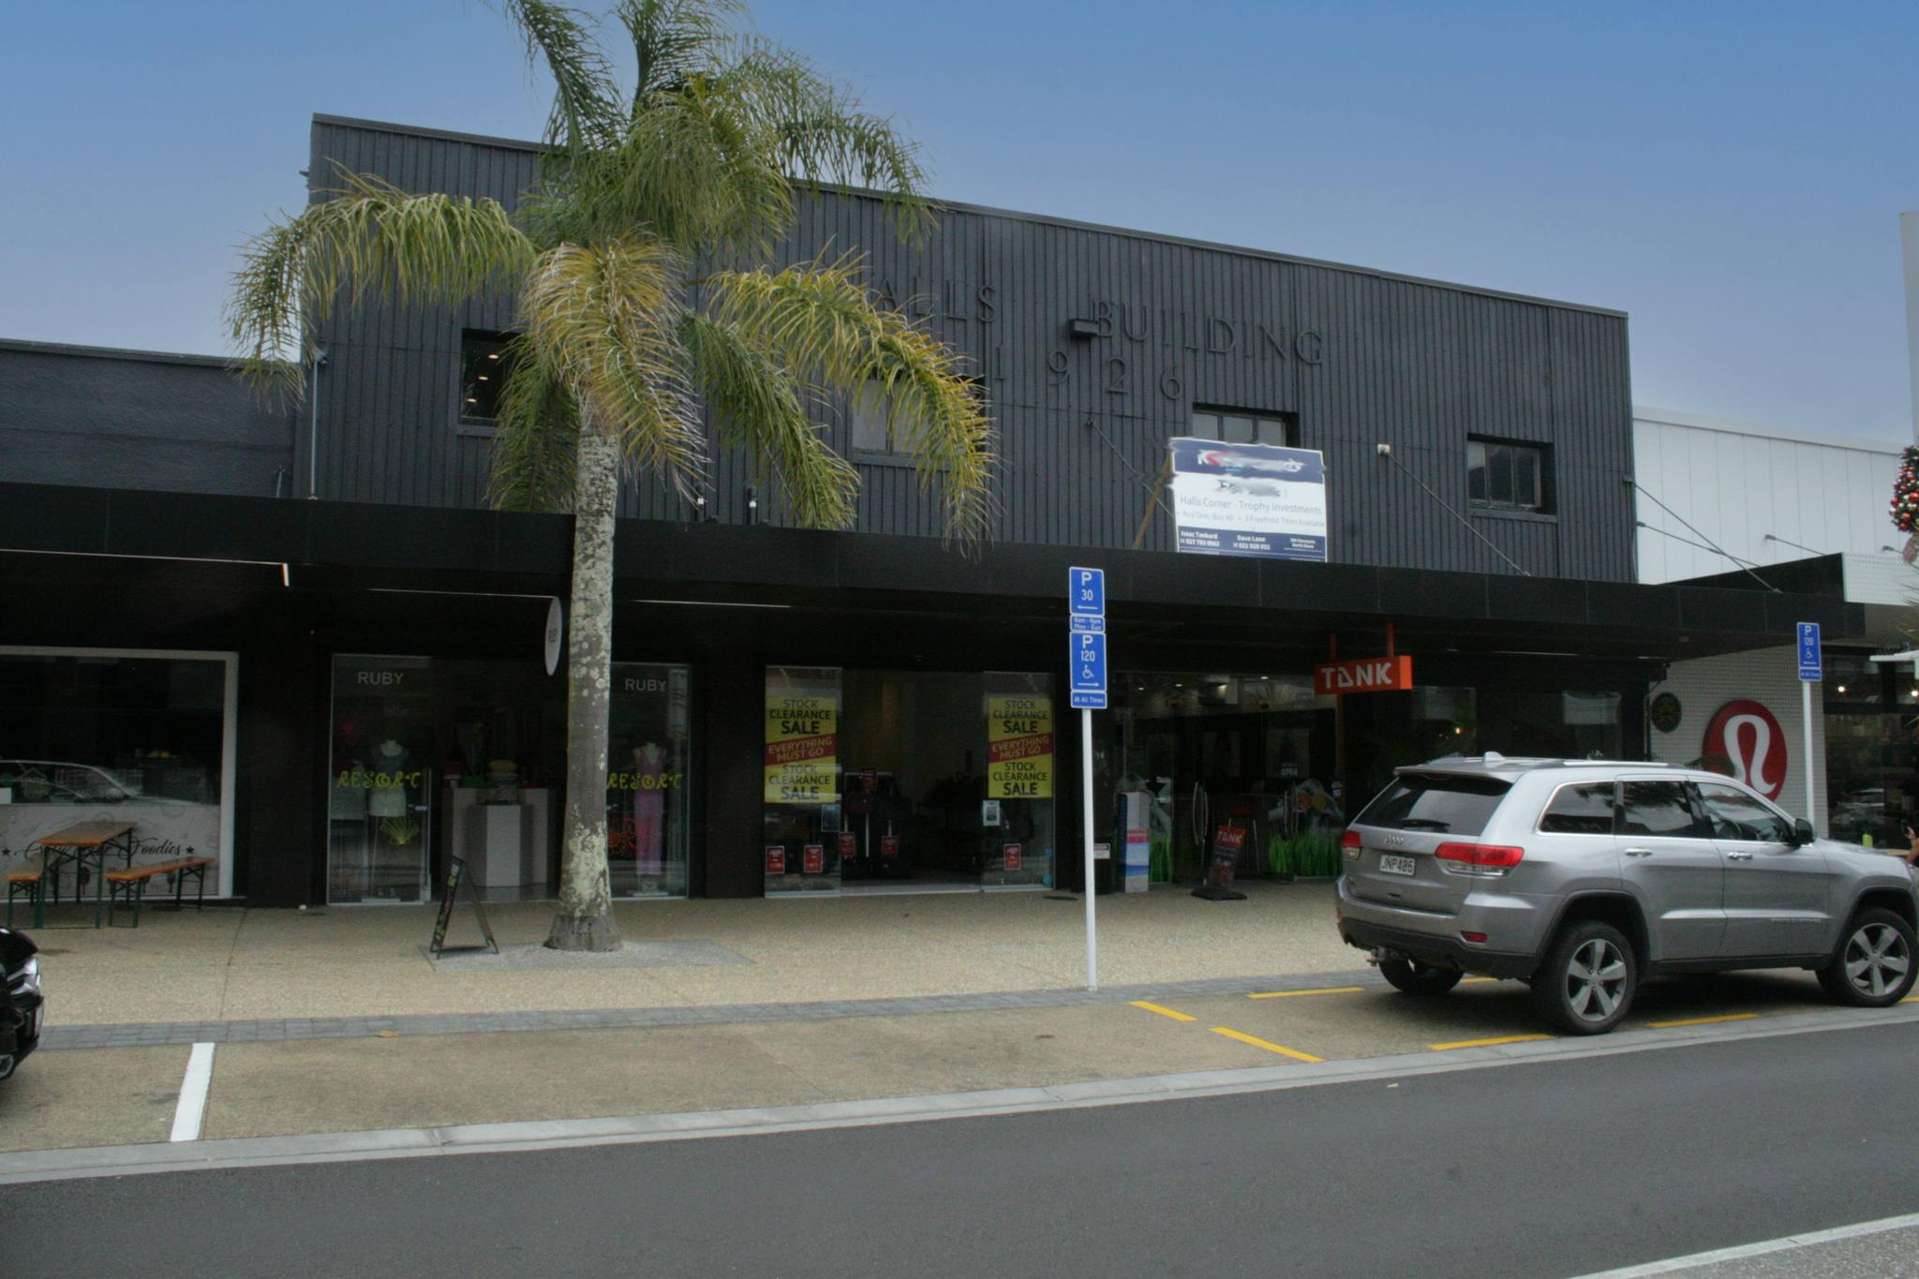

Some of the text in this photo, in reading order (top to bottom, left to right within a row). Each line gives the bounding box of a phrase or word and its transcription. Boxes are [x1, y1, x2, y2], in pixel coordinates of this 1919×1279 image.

[1092, 300, 1323, 367] BUILDING
[1081, 572, 1092, 587] P
[1081, 589, 1094, 601] 30
[1804, 625, 1812, 637] P
[1082, 635, 1094, 649] P
[1081, 650, 1095, 662] 120
[357, 671, 405, 686] RUBY
[1320, 662, 1392, 689] TANK
[624, 678, 667, 692] RUBY
[783, 699, 817, 709] STOCK
[1005, 699, 1035, 709] STOCK
[769, 709, 831, 720] CLEARANCE
[993, 710, 1048, 720] CLEARANCE
[781, 720, 820, 734] SALE
[1003, 720, 1038, 734] SALE
[768, 736, 832, 754] EVERYTHING
[992, 735, 1050, 753] EVERYTHING
[777, 747, 824, 762] MUST GO
[1000, 748, 1028, 761] MUST
[782, 764, 817, 774] STOCK
[1004, 761, 1035, 771] STOCK
[335, 769, 421, 790] RESORT
[607, 771, 683, 791] RESORT
[768, 774, 831, 785] CLEARANCE
[992, 772, 1048, 782] CLEARANCE
[781, 786, 820, 800] SALE
[1003, 782, 1038, 796] SALE
[1216, 828, 1245, 846] TANK
